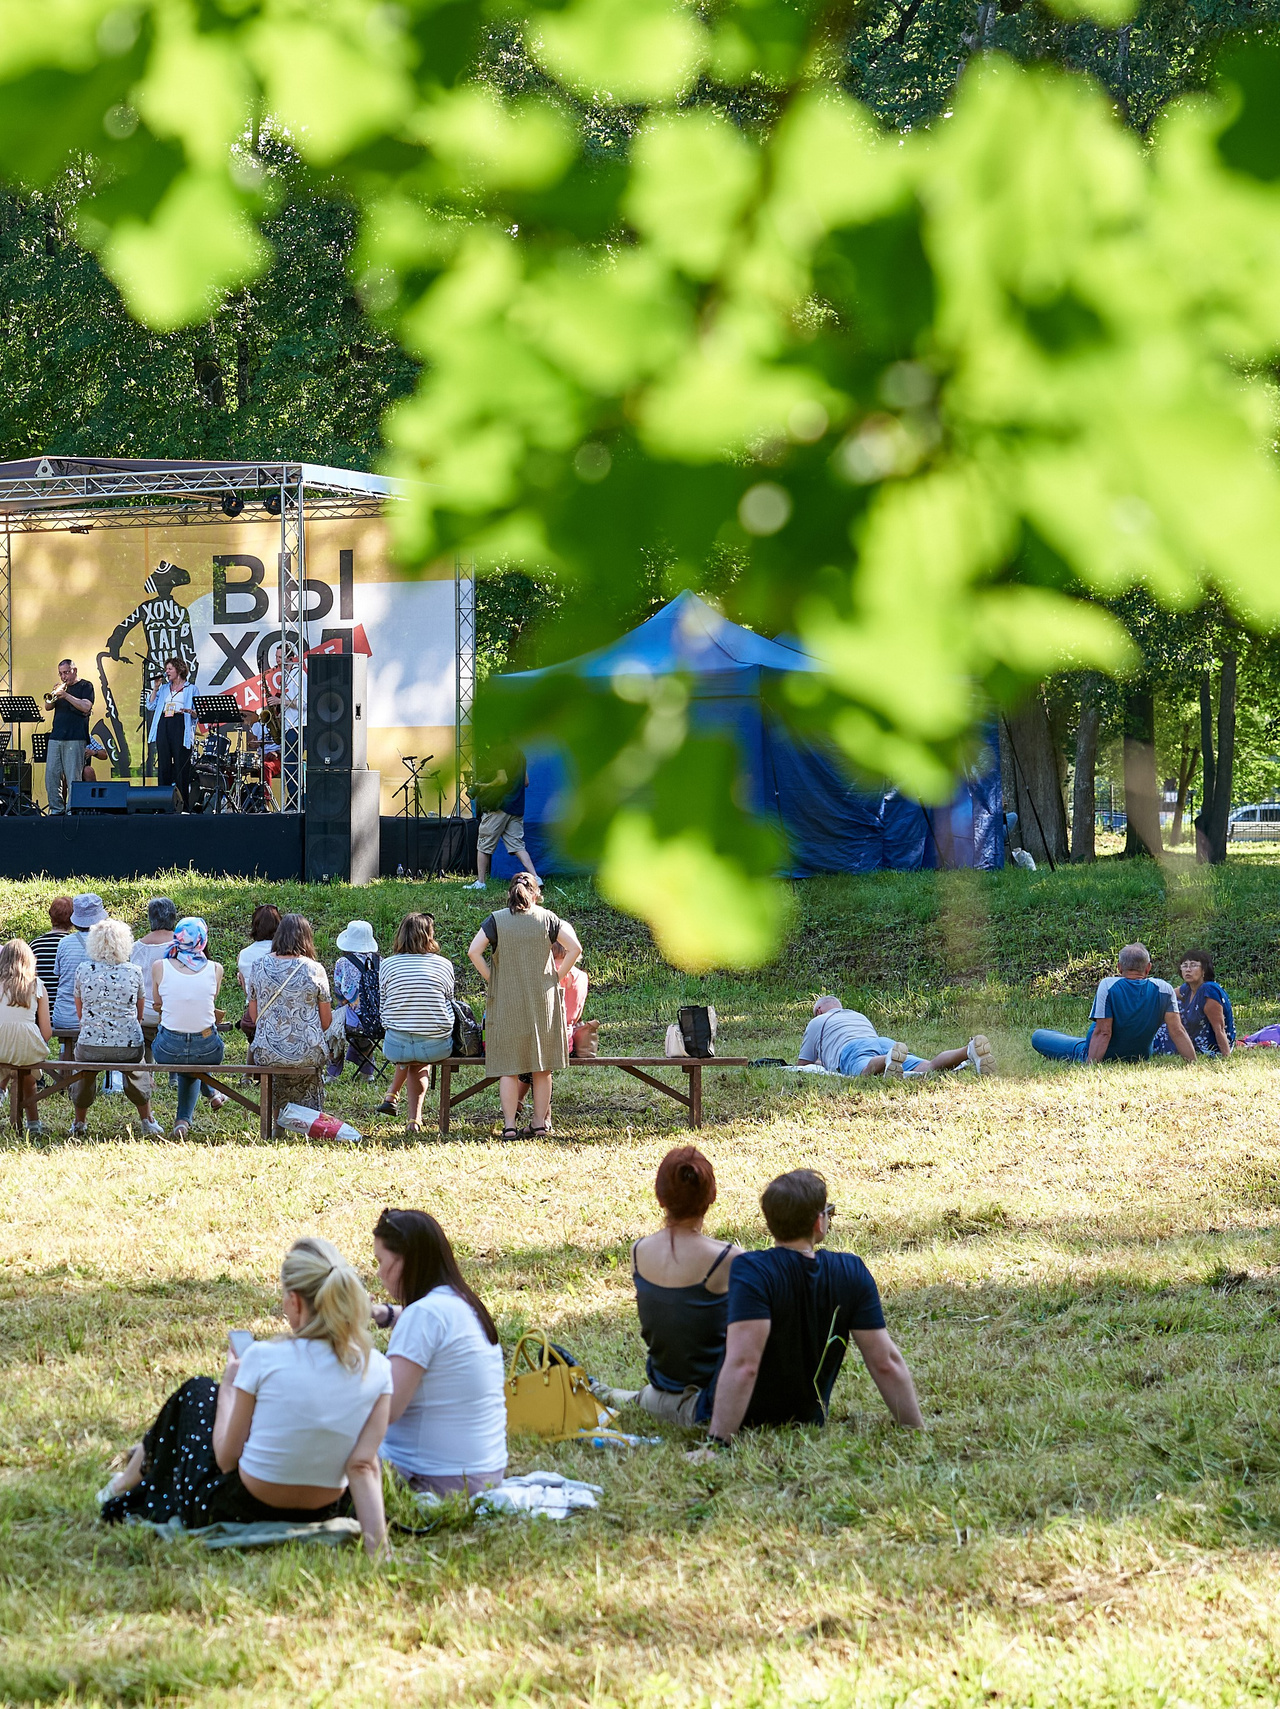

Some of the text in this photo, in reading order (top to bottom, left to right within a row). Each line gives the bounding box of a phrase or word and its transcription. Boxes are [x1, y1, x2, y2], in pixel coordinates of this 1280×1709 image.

[213, 549, 353, 625] ВЫ
[141, 600, 185, 627] ХОЧУ
[149, 628, 178, 650] ГАТ
